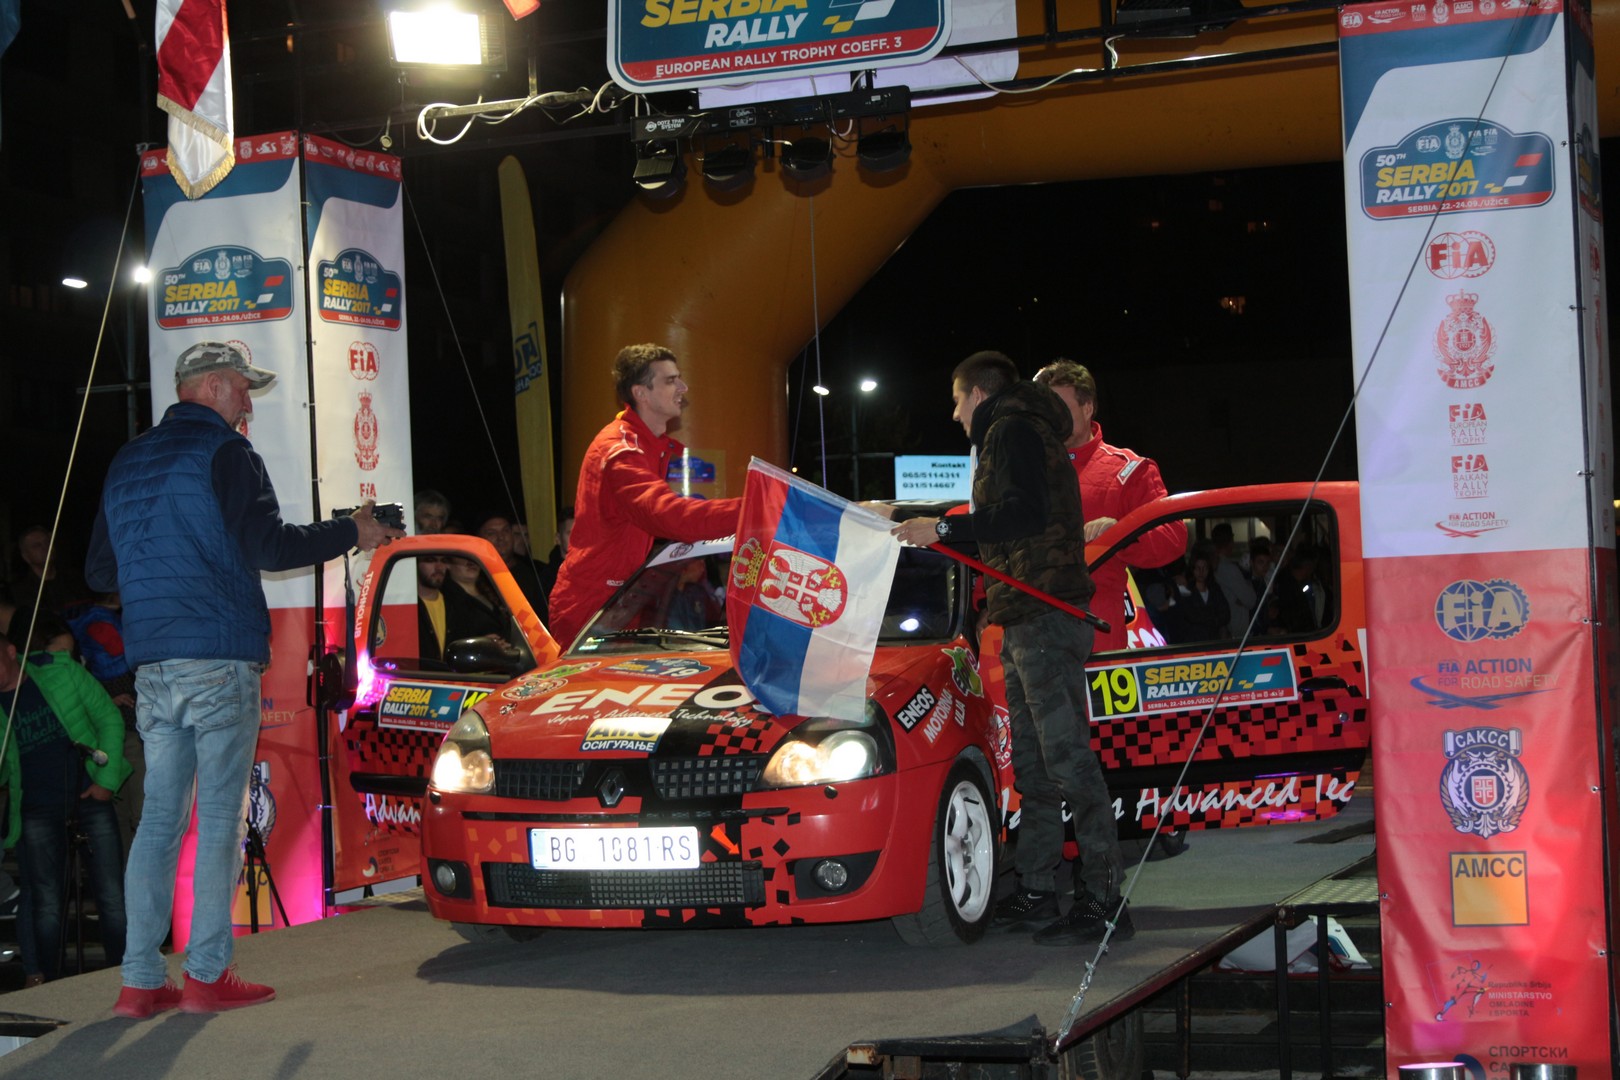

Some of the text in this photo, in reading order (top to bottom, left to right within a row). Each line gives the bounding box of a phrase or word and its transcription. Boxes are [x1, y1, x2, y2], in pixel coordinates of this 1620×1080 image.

[704, 12, 808, 48] RALLY
[656, 36, 902, 77] EUROPEAN RALLY TROPHY COEFF. 3
[1376, 153, 1407, 167] 50TH
[1375, 159, 1475, 188] SERBIA
[1376, 180, 1479, 204] RALLY 2017
[165, 274, 186, 285] 50TH
[165, 280, 238, 302] SERBIA
[323, 278, 369, 300] SERBIA
[165, 298, 241, 316] RALLY 2017
[323, 296, 371, 314] RALLY 2017
[1450, 421, 1488, 430] EUROPEAN
[1451, 428, 1486, 438] RALLY
[1453, 436, 1486, 444] TROPHY
[1453, 473, 1489, 482] BALKAN
[1453, 481, 1489, 490] RALLY
[1455, 489, 1488, 497] TROPHY
[1462, 512, 1496, 520] ACTION
[1481, 519, 1509, 527] SAFETY
[1144, 661, 1230, 685] SERBIA
[1465, 658, 1532, 675] ACTION
[1146, 681, 1197, 699] RALLY
[1438, 674, 1560, 689] FOR ROAD SAFETY
[386, 687, 433, 705] SERBIA
[530, 683, 772, 716] ENEO
[1091, 667, 1138, 716] 19
[261, 711, 296, 723] AFETY
[383, 702, 430, 717] RALLY 2017
[897, 688, 935, 729] ENEOS
[923, 688, 953, 743] MOTORNA
[677, 708, 754, 728] Technology
[1135, 776, 1299, 821] Advanced
[550, 836, 576, 862] BG
[1488, 992, 1552, 1000] MINISTARSTVO
[1488, 1046, 1568, 1058] СПОРТСКИ
